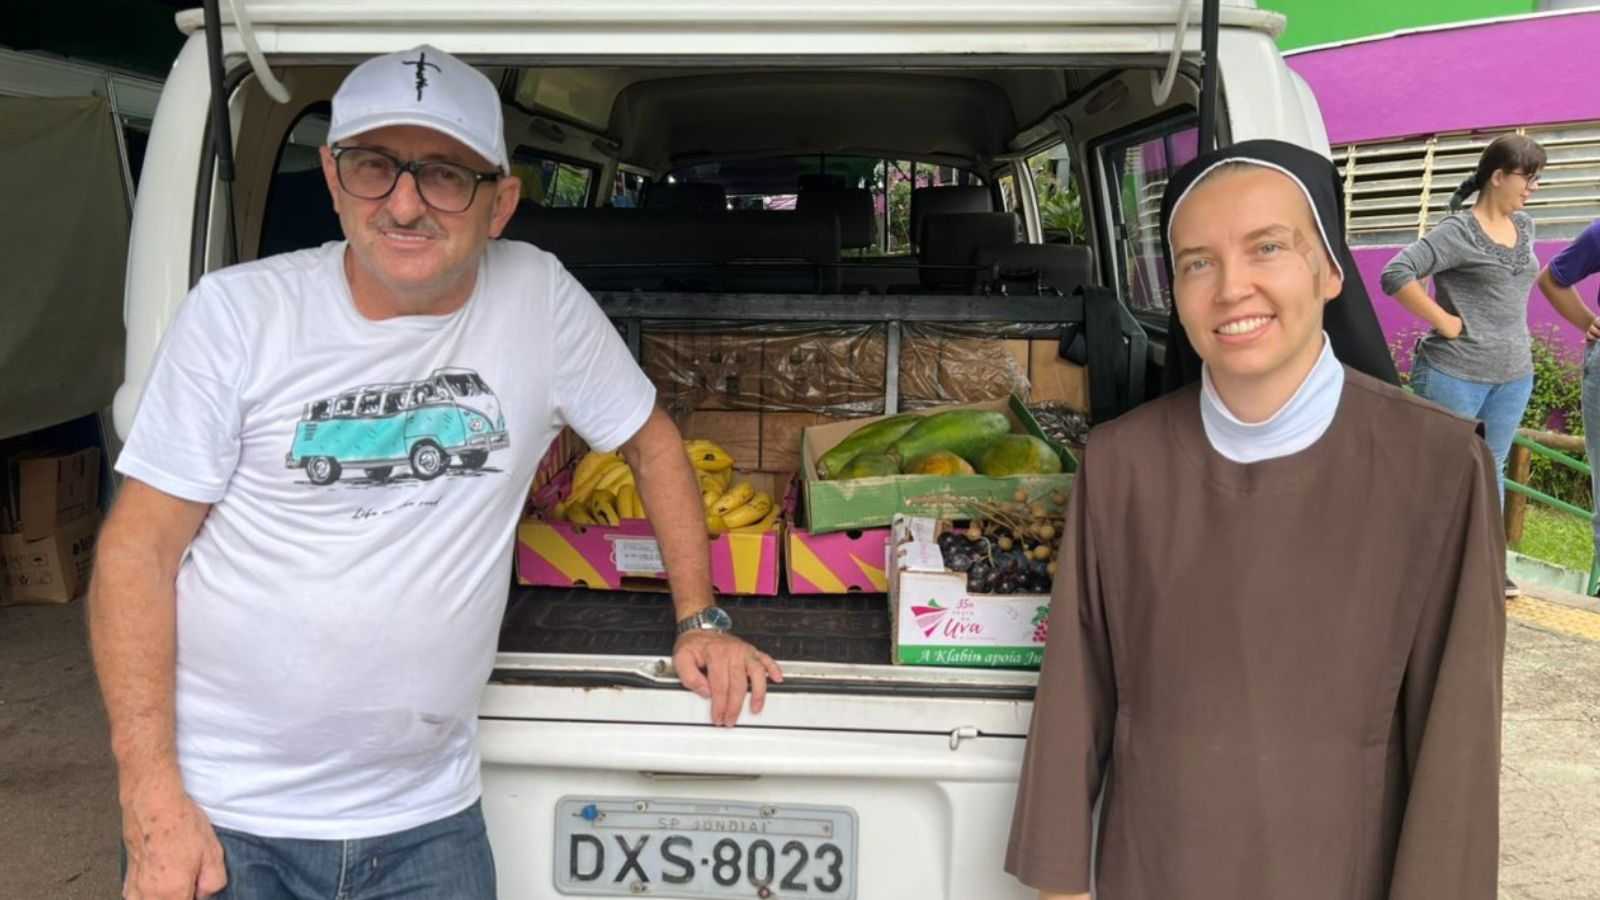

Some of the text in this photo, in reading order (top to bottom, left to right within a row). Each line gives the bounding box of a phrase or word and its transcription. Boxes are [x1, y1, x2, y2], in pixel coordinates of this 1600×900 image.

[944, 618, 983, 639] Uva
[919, 649, 931, 662] A
[934, 648, 981, 664] Klabin
[984, 653, 1022, 666] apoia
